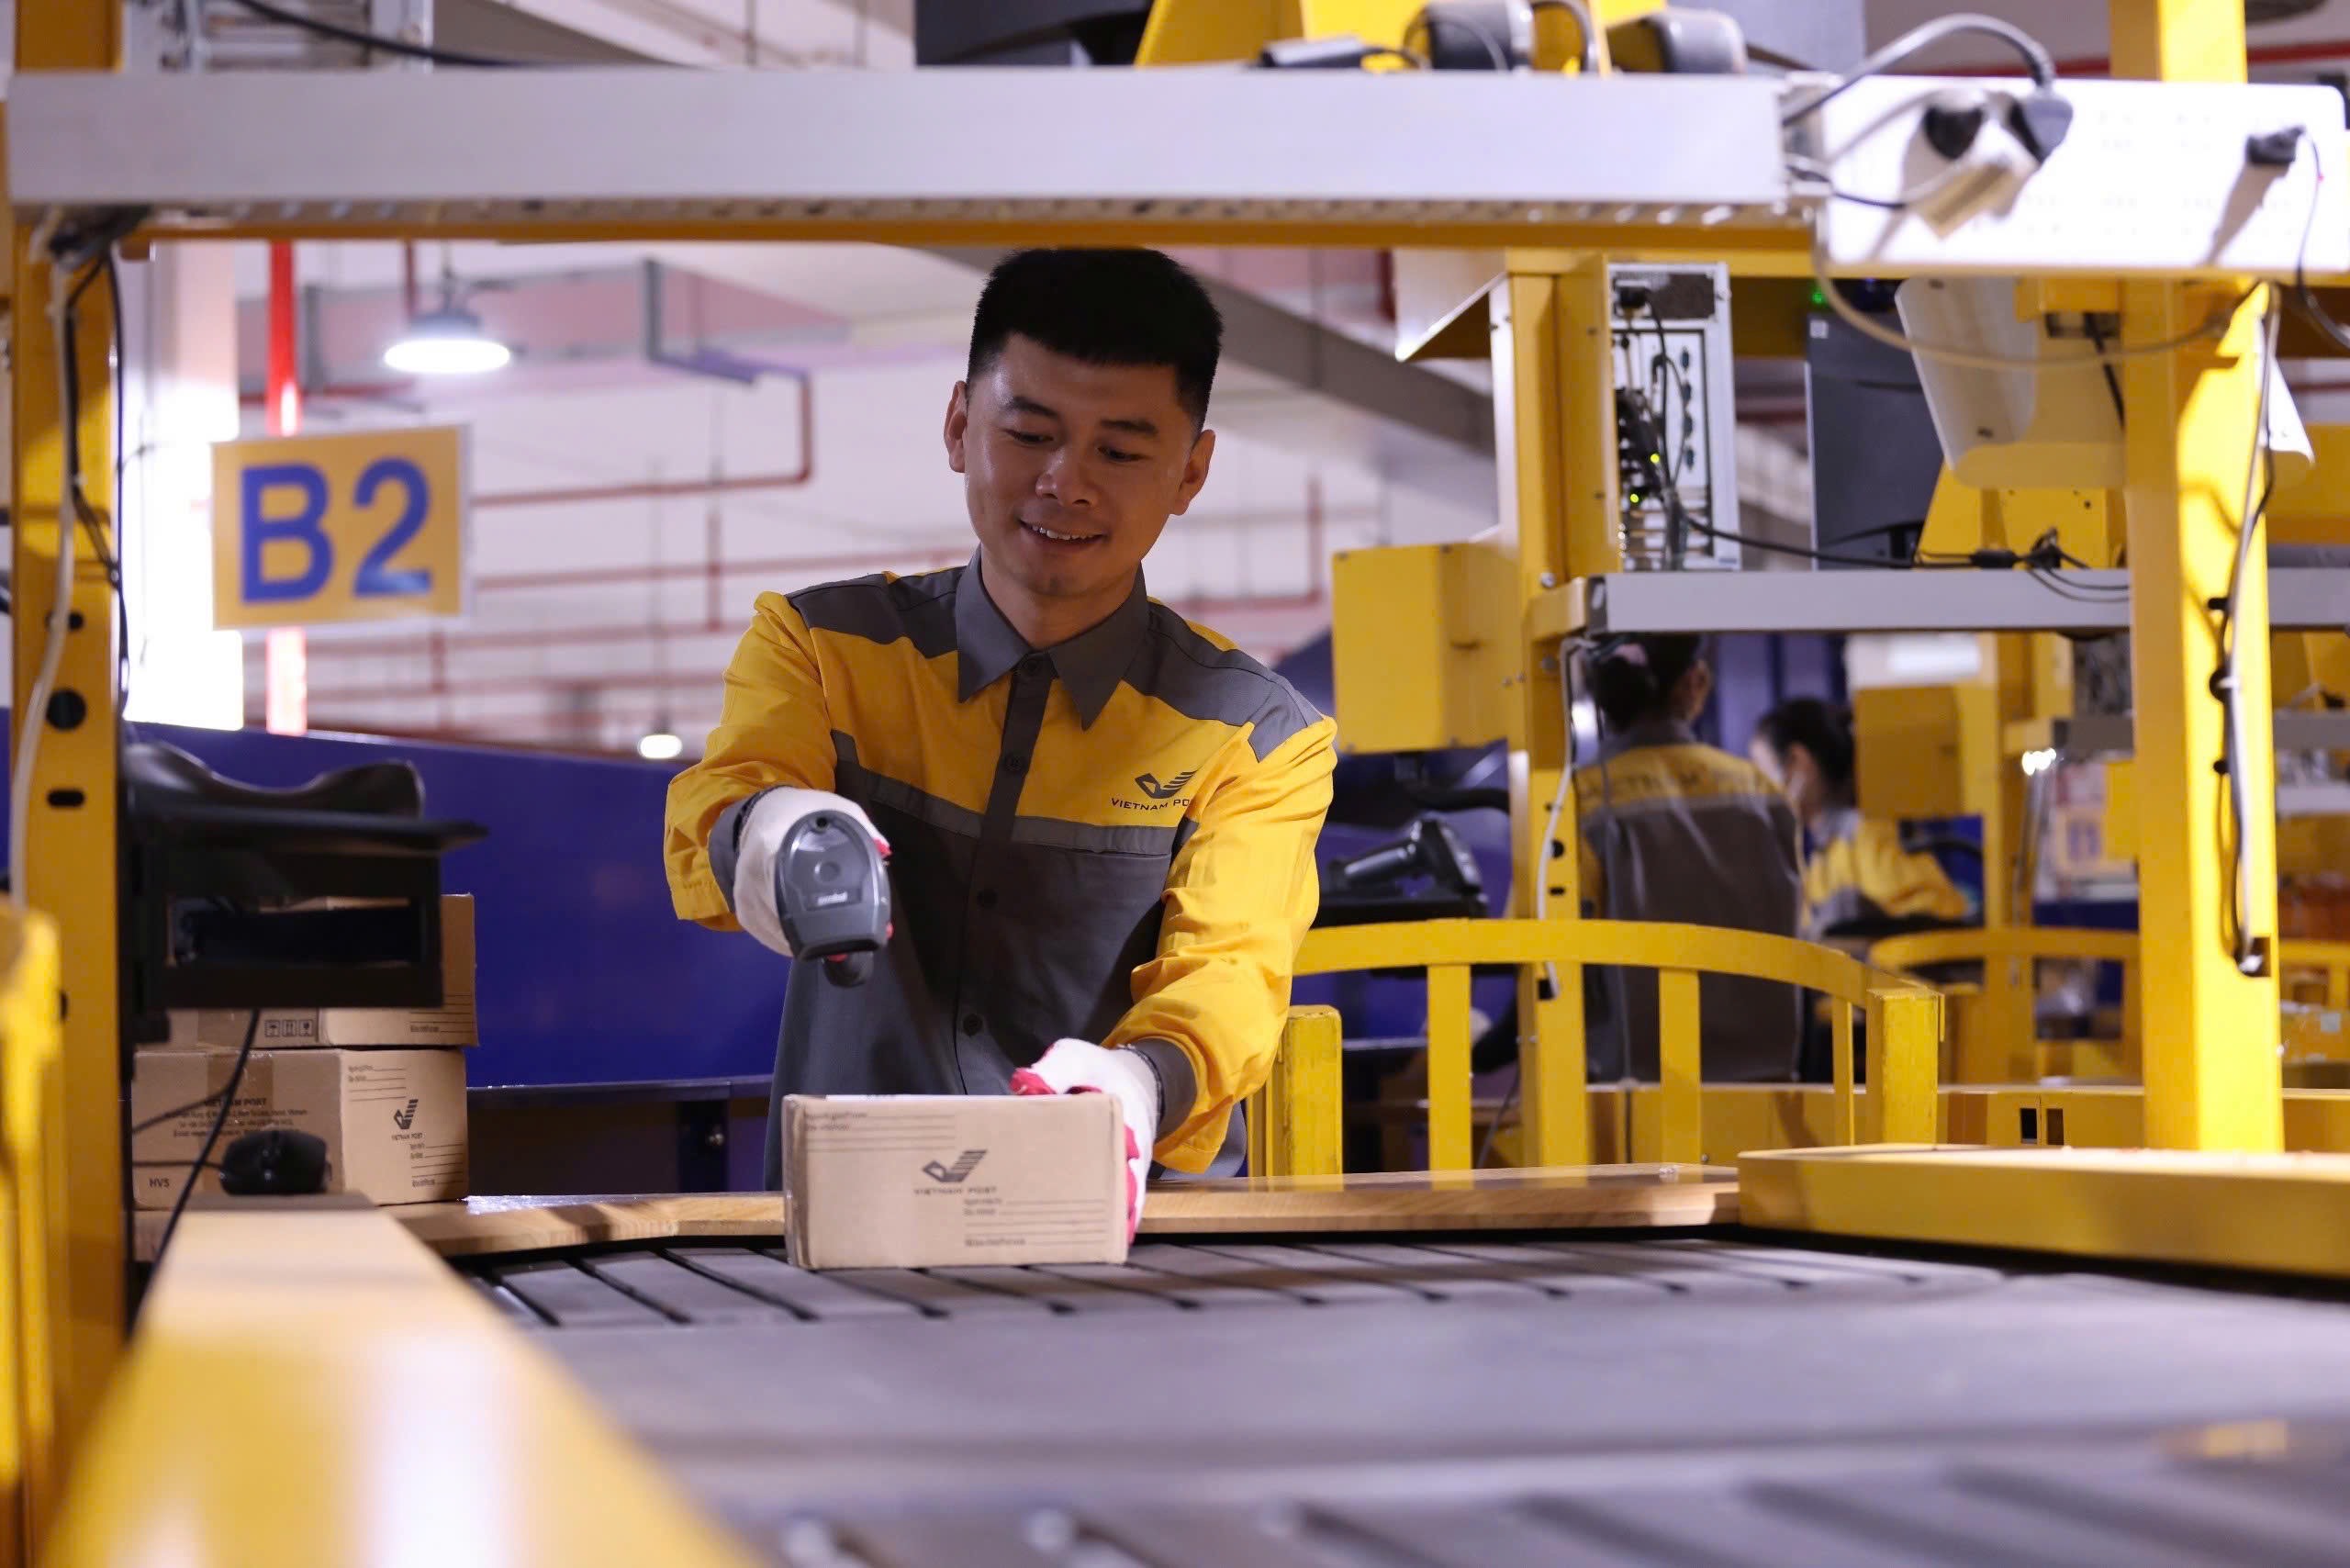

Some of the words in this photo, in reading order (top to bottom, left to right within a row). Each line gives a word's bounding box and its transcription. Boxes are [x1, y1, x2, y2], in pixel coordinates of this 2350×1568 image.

[241, 457, 431, 604] B2
[1111, 798, 1169, 811] VIETNAM
[1173, 799, 1190, 807] PO
